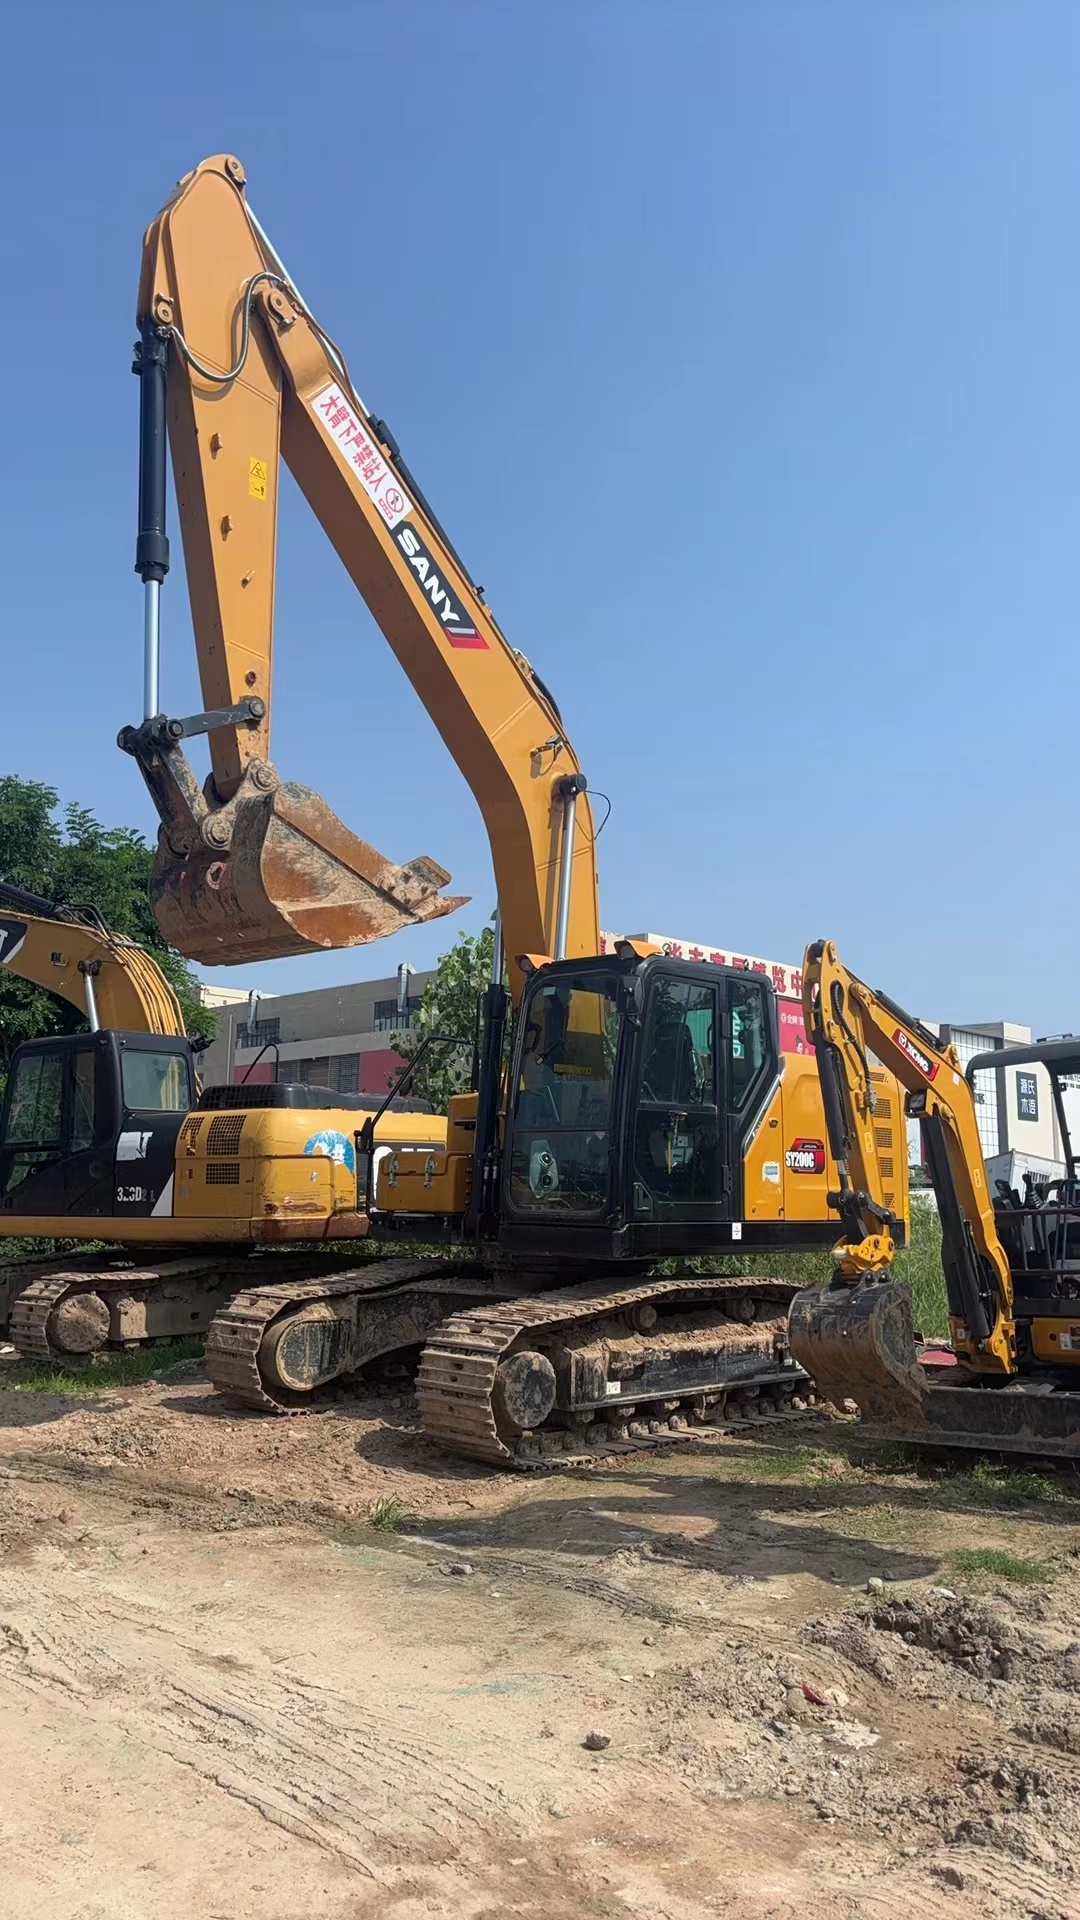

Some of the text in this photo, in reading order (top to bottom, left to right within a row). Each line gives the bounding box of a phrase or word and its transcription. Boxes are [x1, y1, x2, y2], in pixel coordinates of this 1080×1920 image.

[319, 395, 388, 493] 大臂下严禁站人
[397, 528, 460, 624] SANY
[906, 1041, 929, 1073] XCMG
[785, 1151, 815, 1168] SY200C
